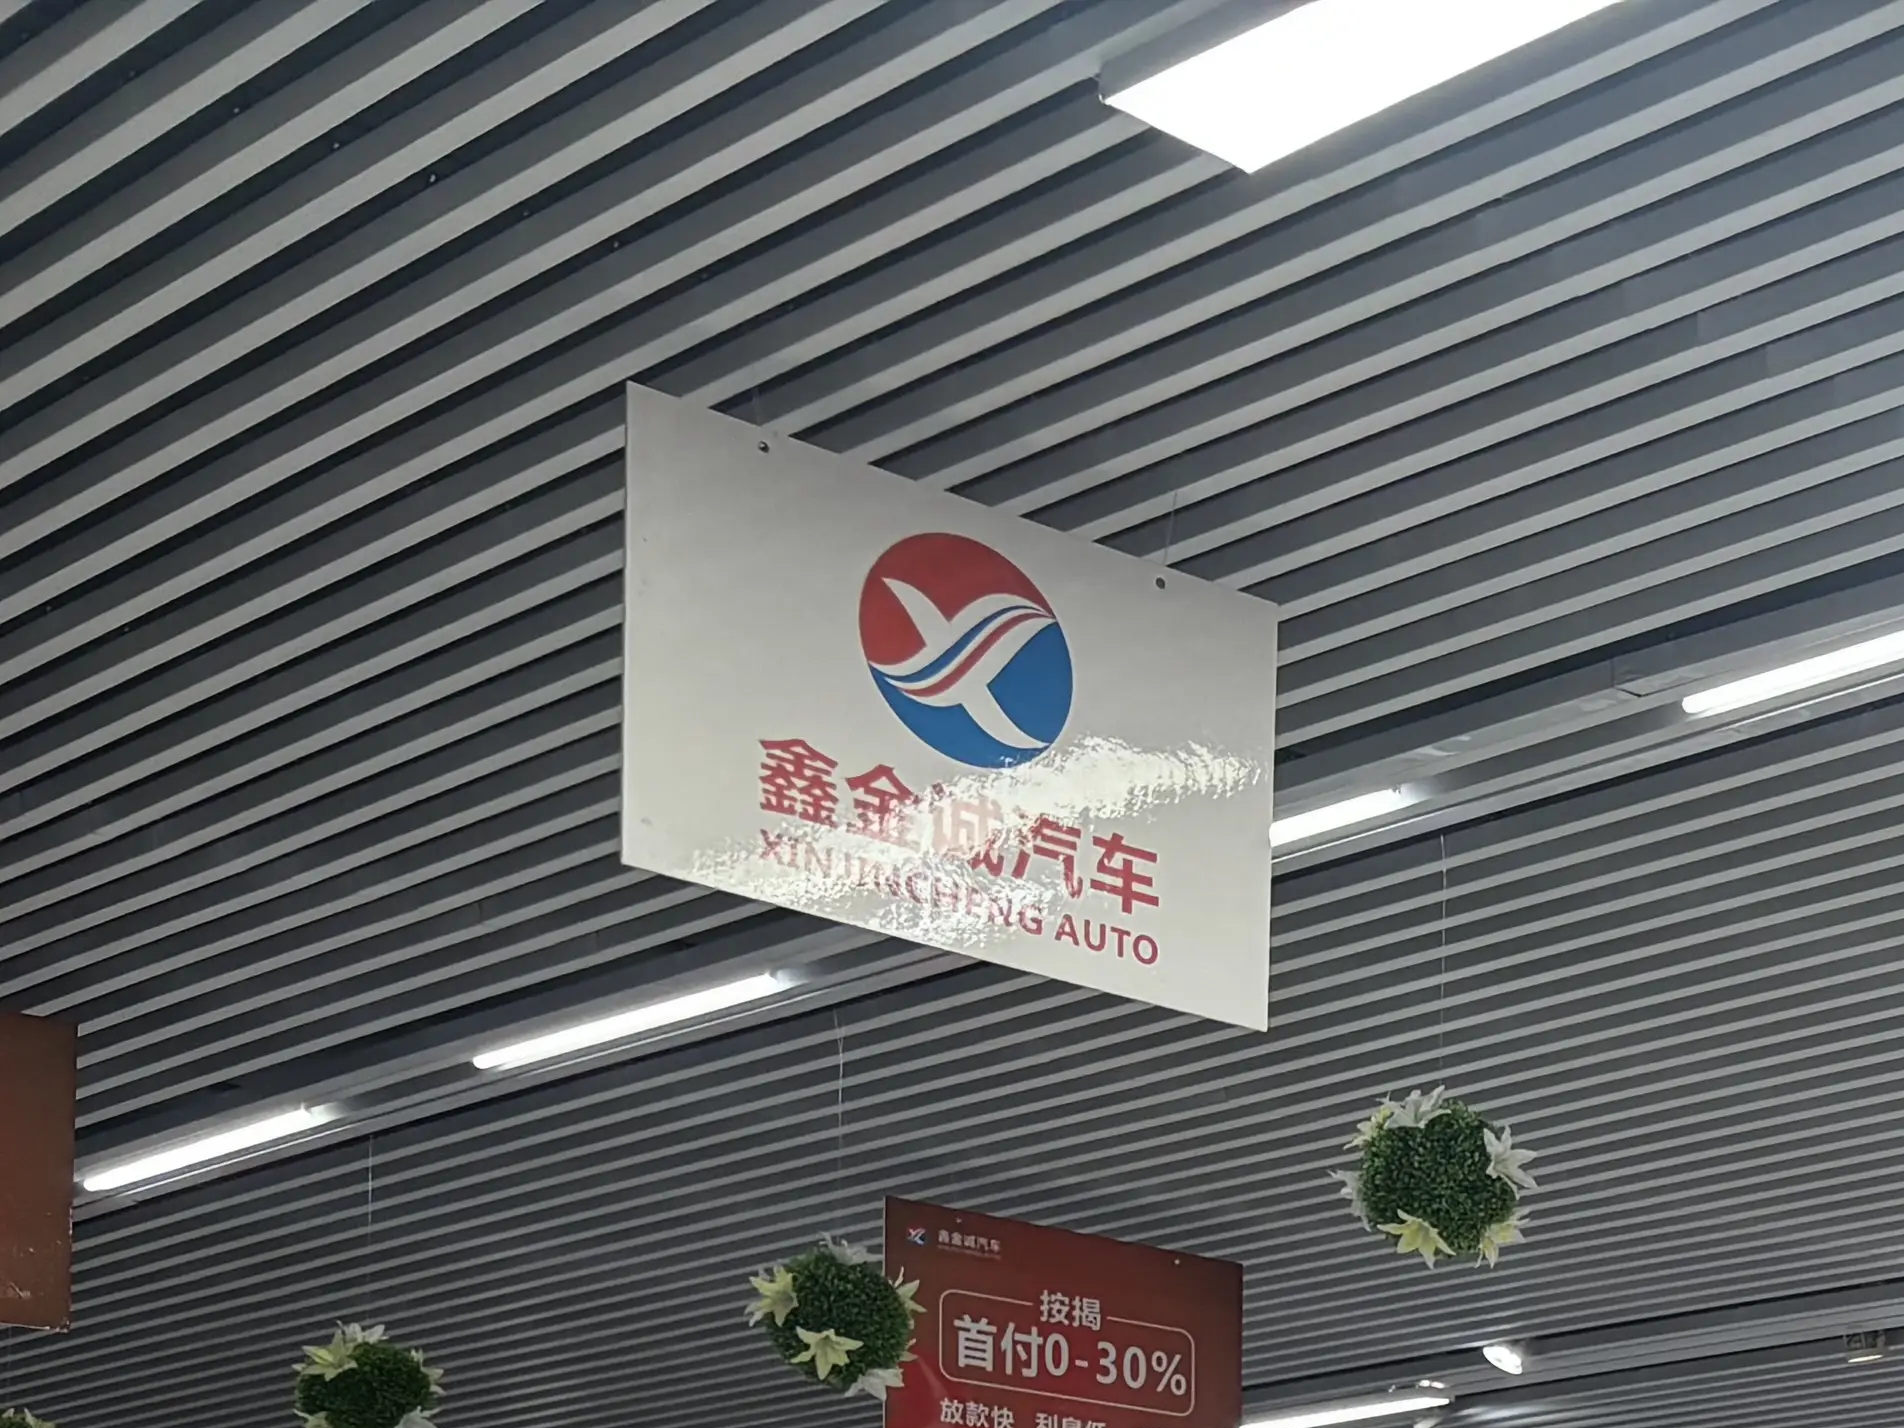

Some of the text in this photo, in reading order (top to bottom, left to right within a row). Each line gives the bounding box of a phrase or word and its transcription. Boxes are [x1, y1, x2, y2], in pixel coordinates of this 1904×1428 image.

[758, 738, 1160, 915] 鑫金诚汽车
[1054, 913, 1160, 967] AUTO
[1040, 1289, 1102, 1331] 按揭
[953, 1314, 1187, 1396] 首付0-30%
